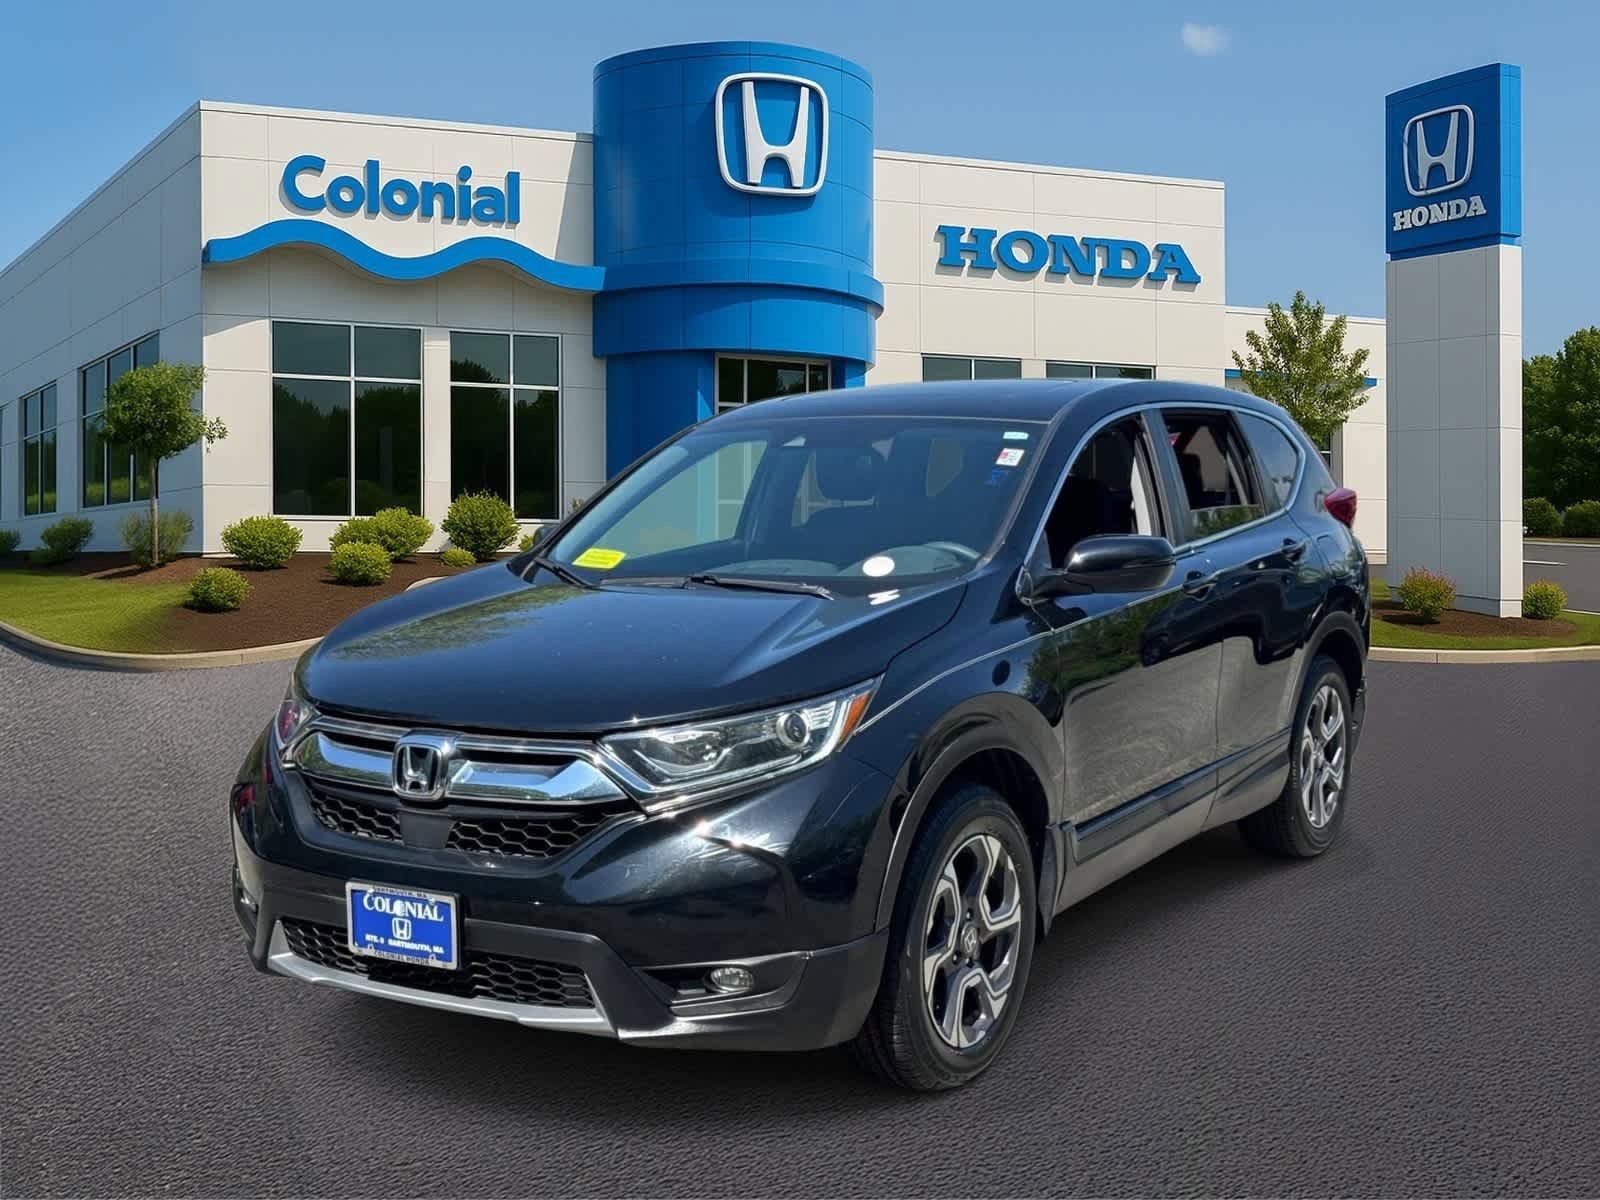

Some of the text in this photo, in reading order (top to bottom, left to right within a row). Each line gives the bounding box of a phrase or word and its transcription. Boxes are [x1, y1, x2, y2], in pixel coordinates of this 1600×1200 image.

[281, 154, 520, 226] Colonial
[1392, 195, 1487, 231] HONDA
[936, 225, 1202, 288] HONDA
[363, 893, 444, 921] COLONIAL
